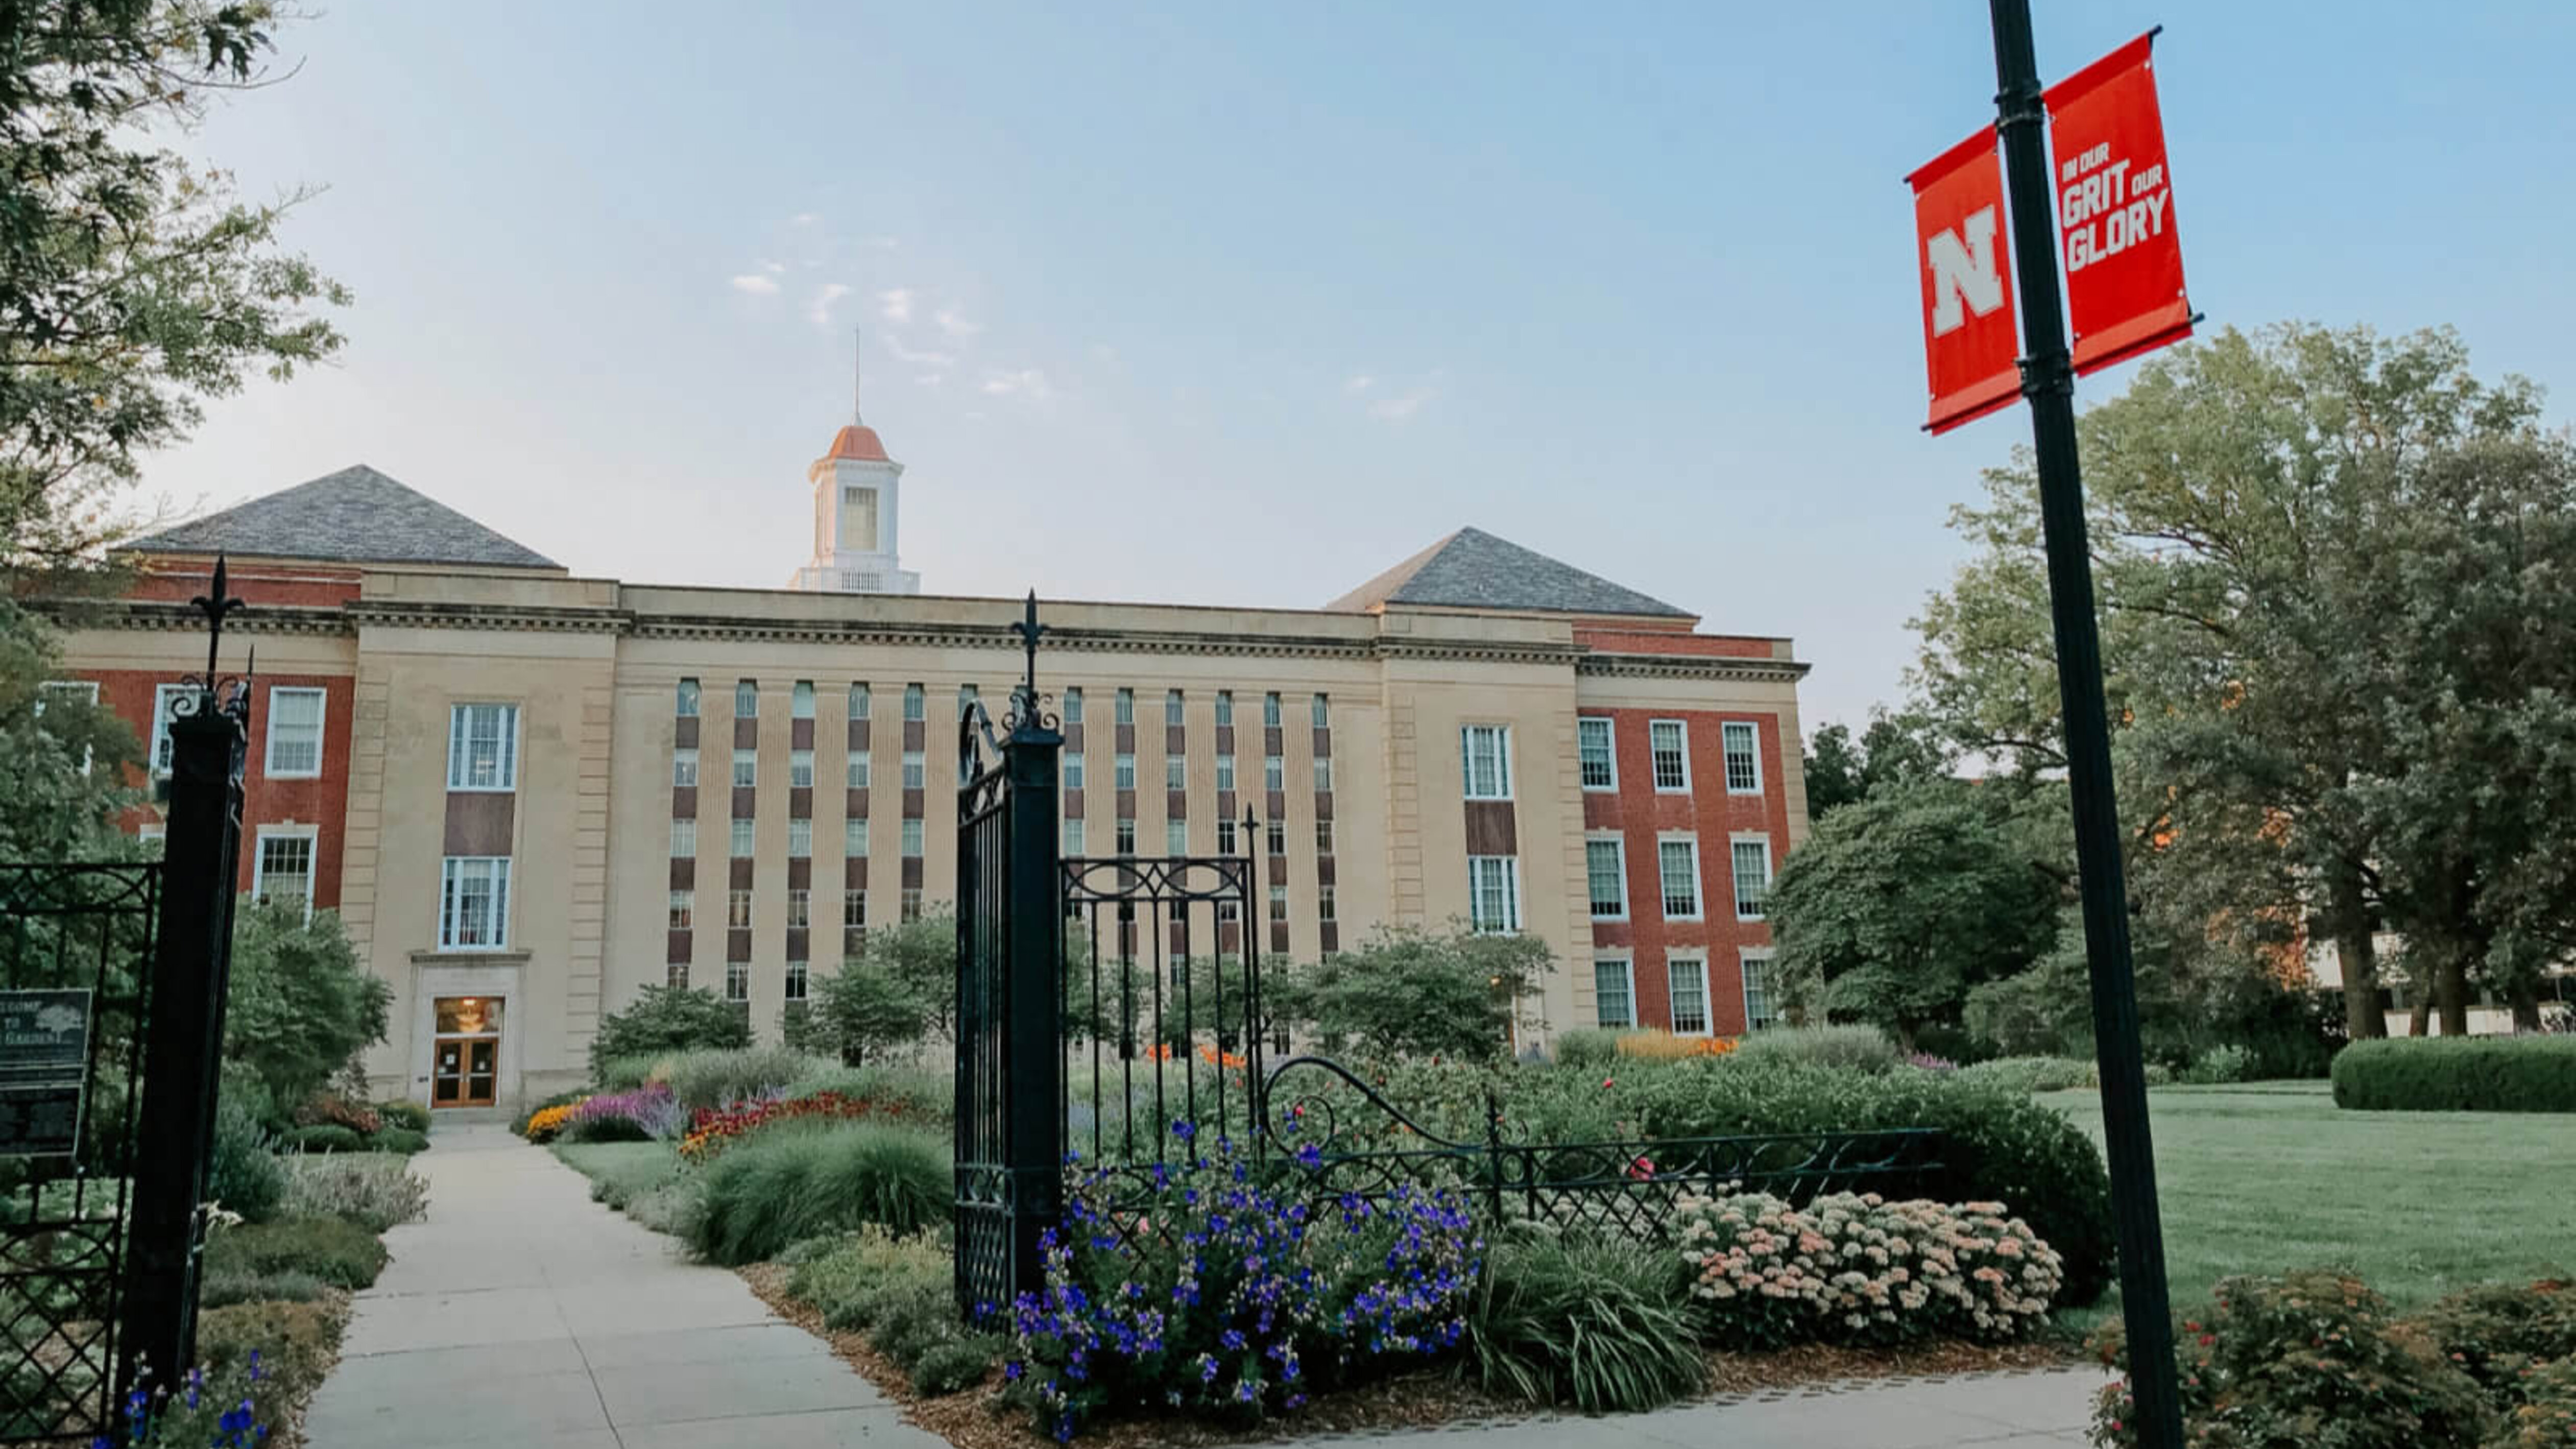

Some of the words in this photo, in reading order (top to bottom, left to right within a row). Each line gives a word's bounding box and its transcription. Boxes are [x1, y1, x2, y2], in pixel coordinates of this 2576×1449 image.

[2062, 157, 2078, 183] IN
[2080, 142, 2109, 174] OUR
[2063, 158, 2130, 228] GRIT
[2131, 164, 2162, 197] OUR
[2068, 187, 2169, 272] GLORY
[1927, 205, 2004, 338] N
